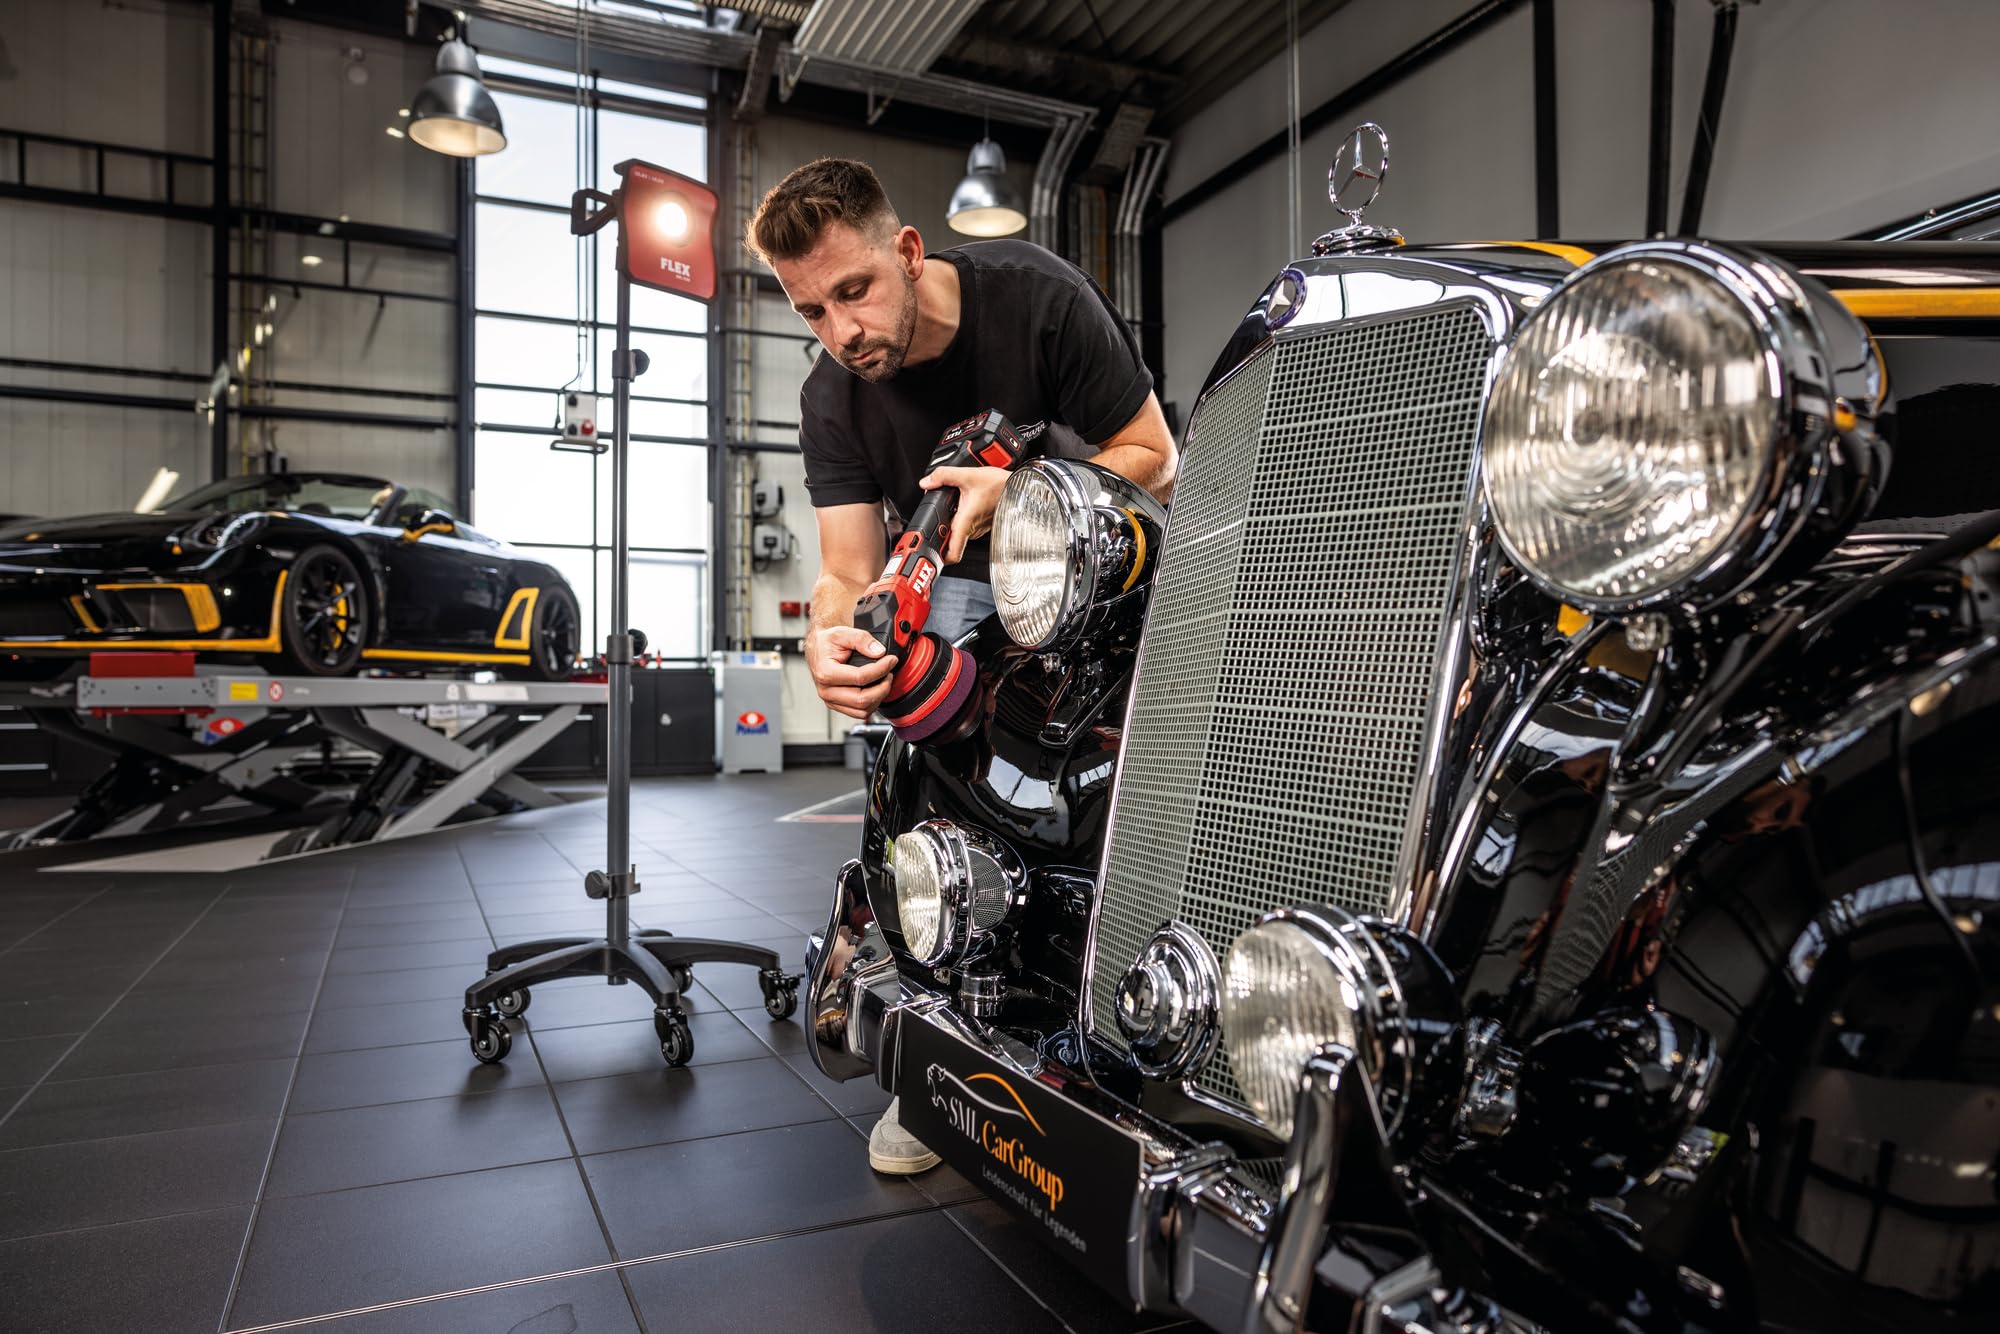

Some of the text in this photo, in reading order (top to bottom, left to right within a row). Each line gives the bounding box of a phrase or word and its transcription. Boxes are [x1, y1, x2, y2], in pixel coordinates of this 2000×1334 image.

[661, 257, 691, 277] FLEX
[912, 562, 933, 594] FLEX
[949, 1096, 1064, 1211] SML CarGroup
